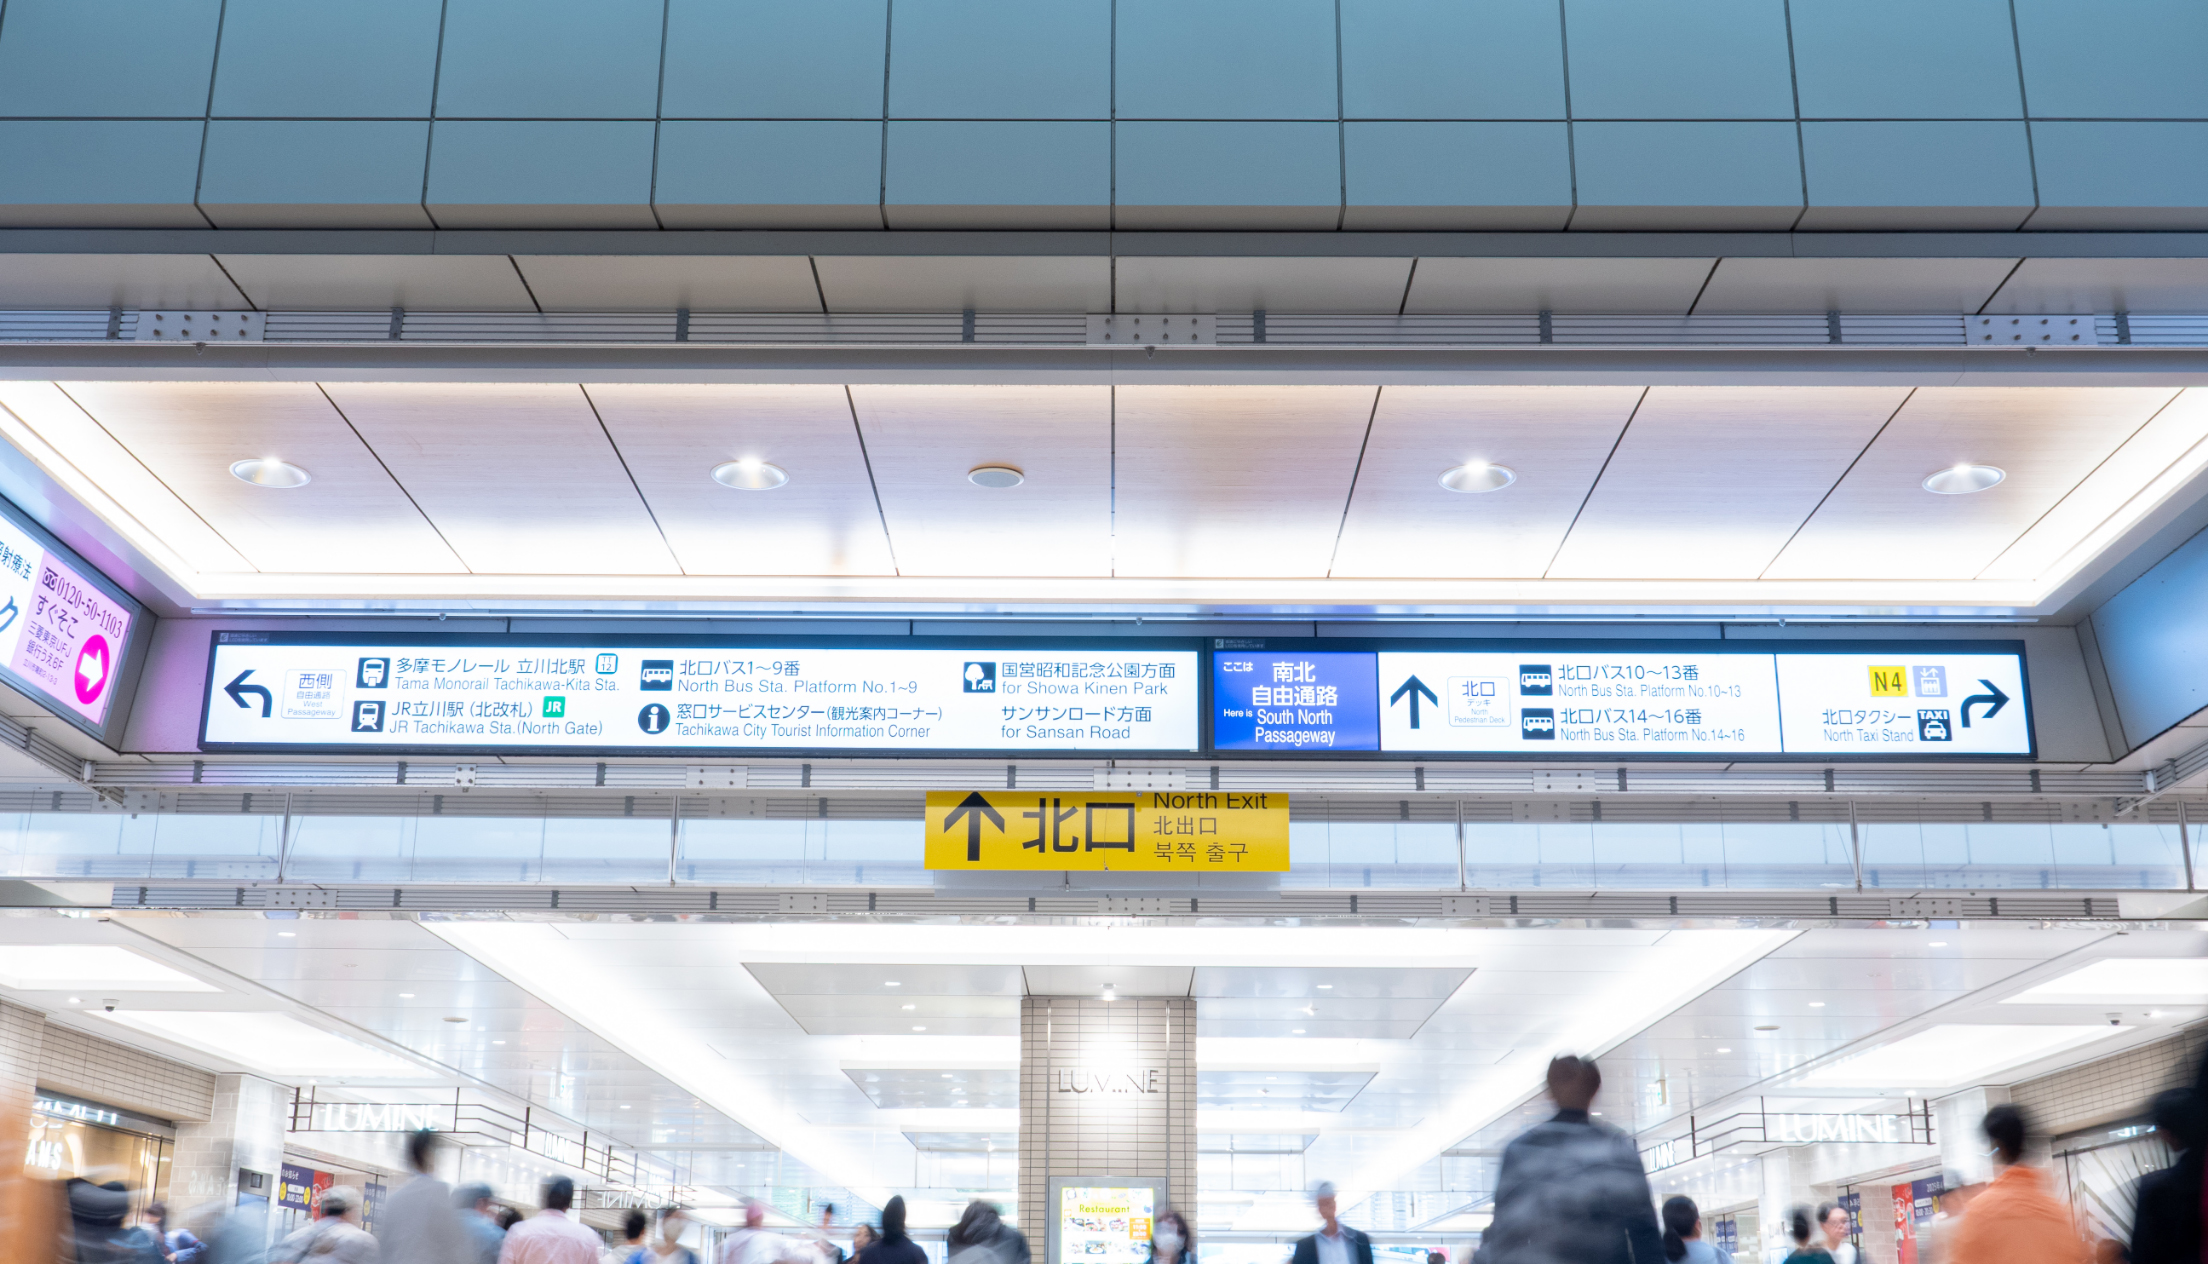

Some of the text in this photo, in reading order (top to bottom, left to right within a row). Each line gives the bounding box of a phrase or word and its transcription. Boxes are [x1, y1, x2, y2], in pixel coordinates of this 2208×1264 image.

[58, 577, 122, 638] 0120-50-1103
[36, 595, 78, 639] すぐそこ
[28, 621, 72, 658] 三菱東京UFJ
[26, 639, 64, 670] 銀行うえ6F
[396, 658, 585, 674] 多摩モノレール 立川北駅
[601, 663, 612, 671] 12
[1002, 662, 1176, 679] 国営昭和記念公園方面
[1223, 662, 1253, 672] ここは
[1273, 661, 1315, 683] 南北
[299, 674, 332, 689] 西側
[395, 677, 620, 691] Tama Monorail Tachikawa-Kita Sta.
[678, 679, 719, 694] North
[725, 679, 753, 694] Bus
[759, 680, 788, 694] Sta.
[794, 680, 857, 694] Platform
[1002, 681, 1168, 695] for Showa Kinen Park
[1461, 680, 1495, 698] 北口
[1874, 672, 1902, 691] N4
[297, 691, 330, 699] 自由通路
[1252, 685, 1338, 707] 自由通路
[1559, 684, 1588, 697] North
[1592, 684, 1613, 698] Bus
[1618, 684, 1637, 698] Sta.
[1641, 684, 1683, 698] Platform
[545, 700, 562, 713] JR
[1467, 699, 1491, 708] デッキ
[287, 708, 335, 717] Passageway
[1001, 706, 1152, 723] サンサンロード方面
[1223, 709, 1253, 718] Here is
[1257, 708, 1332, 725] South North
[1454, 716, 1505, 724] Pedestrian Deck
[1823, 709, 1911, 725] 北口タクシー
[1919, 711, 1948, 720] TAXI
[390, 720, 408, 733] JR
[415, 720, 484, 734] Tachikawa
[565, 721, 603, 736] Gate)
[676, 723, 930, 740] Tachikawa City Tourist Information Corner
[1001, 725, 1131, 739] for Sansan Road
[1561, 728, 1591, 742] North
[1595, 728, 1616, 742] Bus
[1620, 728, 1640, 742] Sta.
[1644, 728, 1686, 742] Platform
[1824, 729, 1913, 741] North Taxi Stand
[1255, 727, 1335, 747] Passageway
[1154, 793, 1268, 809] North Exit
[1022, 797, 1135, 853] 北口
[1153, 815, 1217, 835] 北出口
[1154, 842, 1248, 862] 북쪽 출구
[324, 1103, 440, 1132] LUMINE
[1779, 1114, 1899, 1144] LUMINE
[1079, 1203, 1131, 1214] Restaurant
